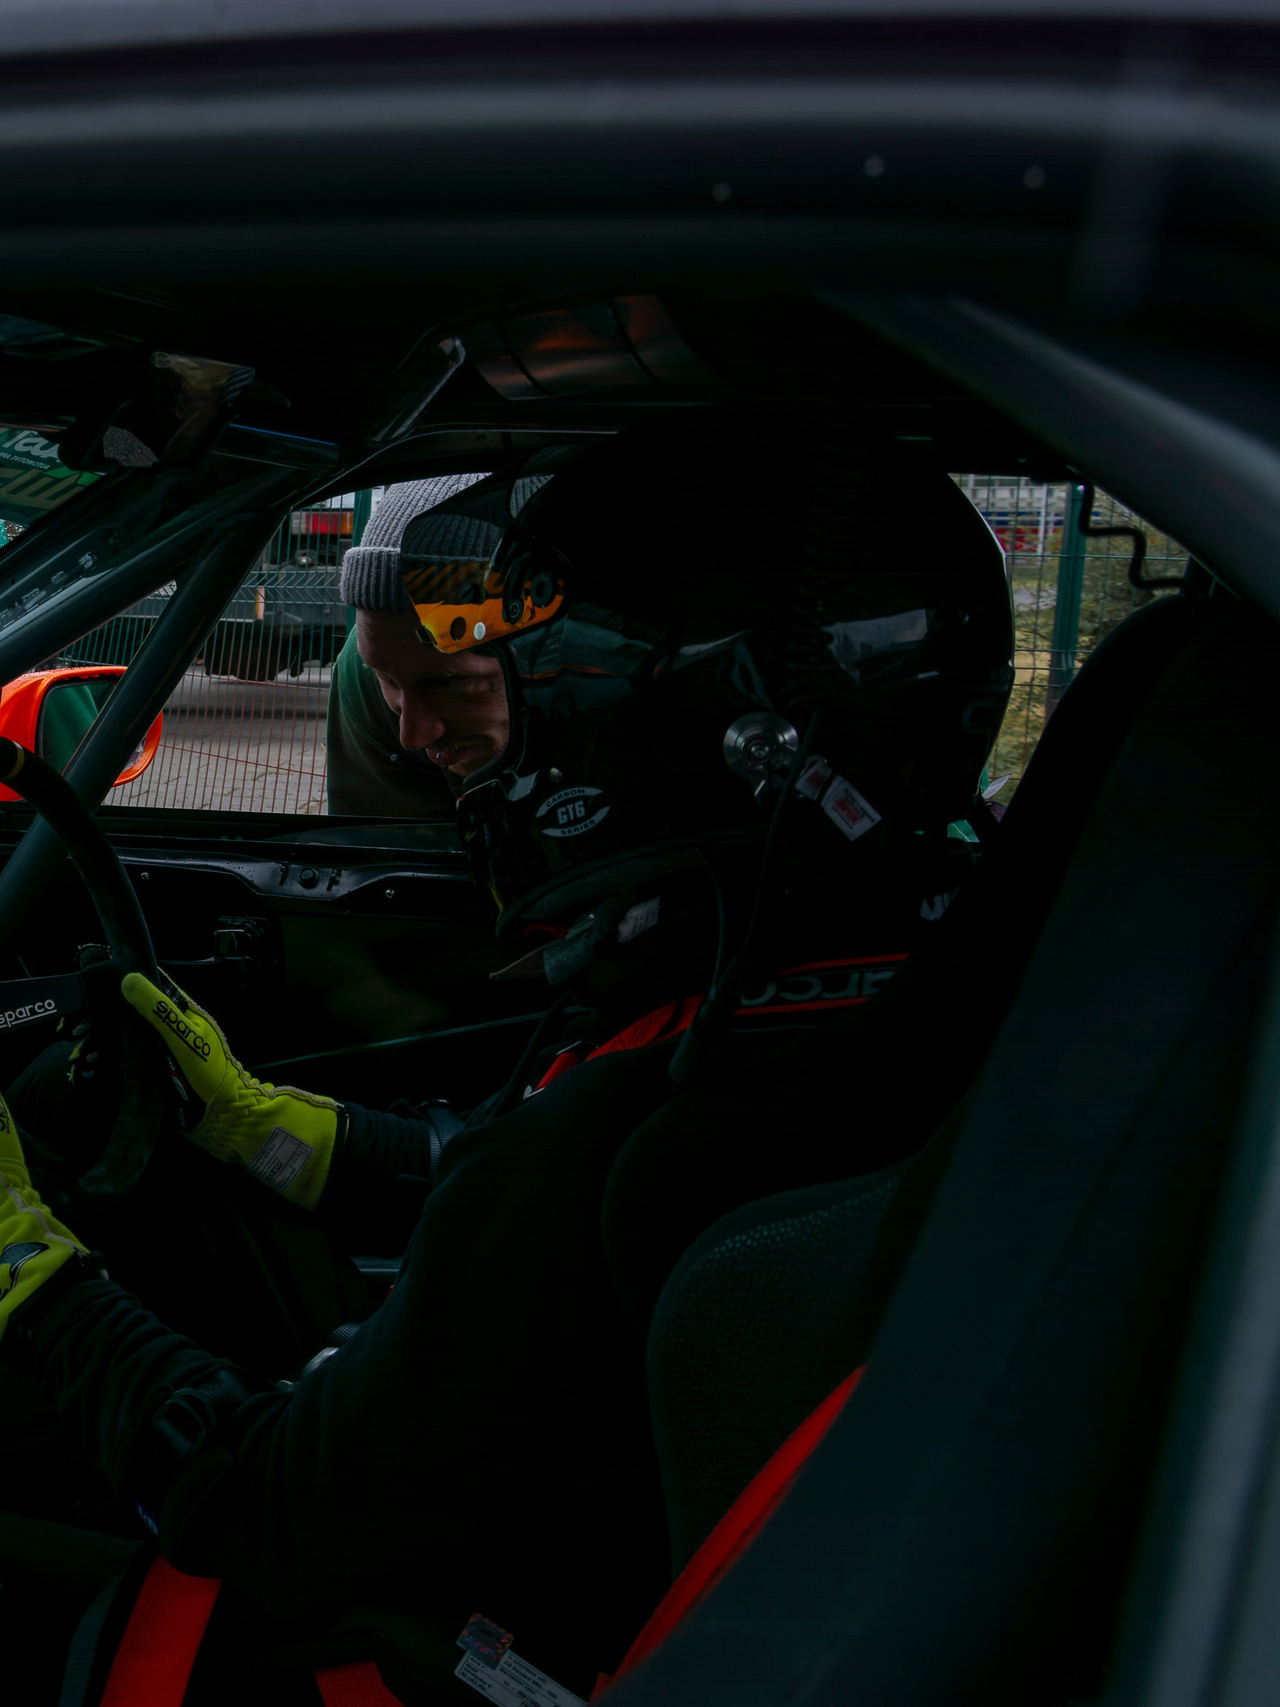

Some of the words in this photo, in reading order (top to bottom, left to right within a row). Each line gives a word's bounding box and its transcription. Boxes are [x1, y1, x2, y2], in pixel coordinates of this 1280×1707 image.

[546, 789, 585, 807] CARBON
[560, 819, 595, 835] SERIES
[740, 970, 896, 1006] arco
[150, 1000, 211, 1061] sparco
[511, 1665, 531, 1681] Standard
